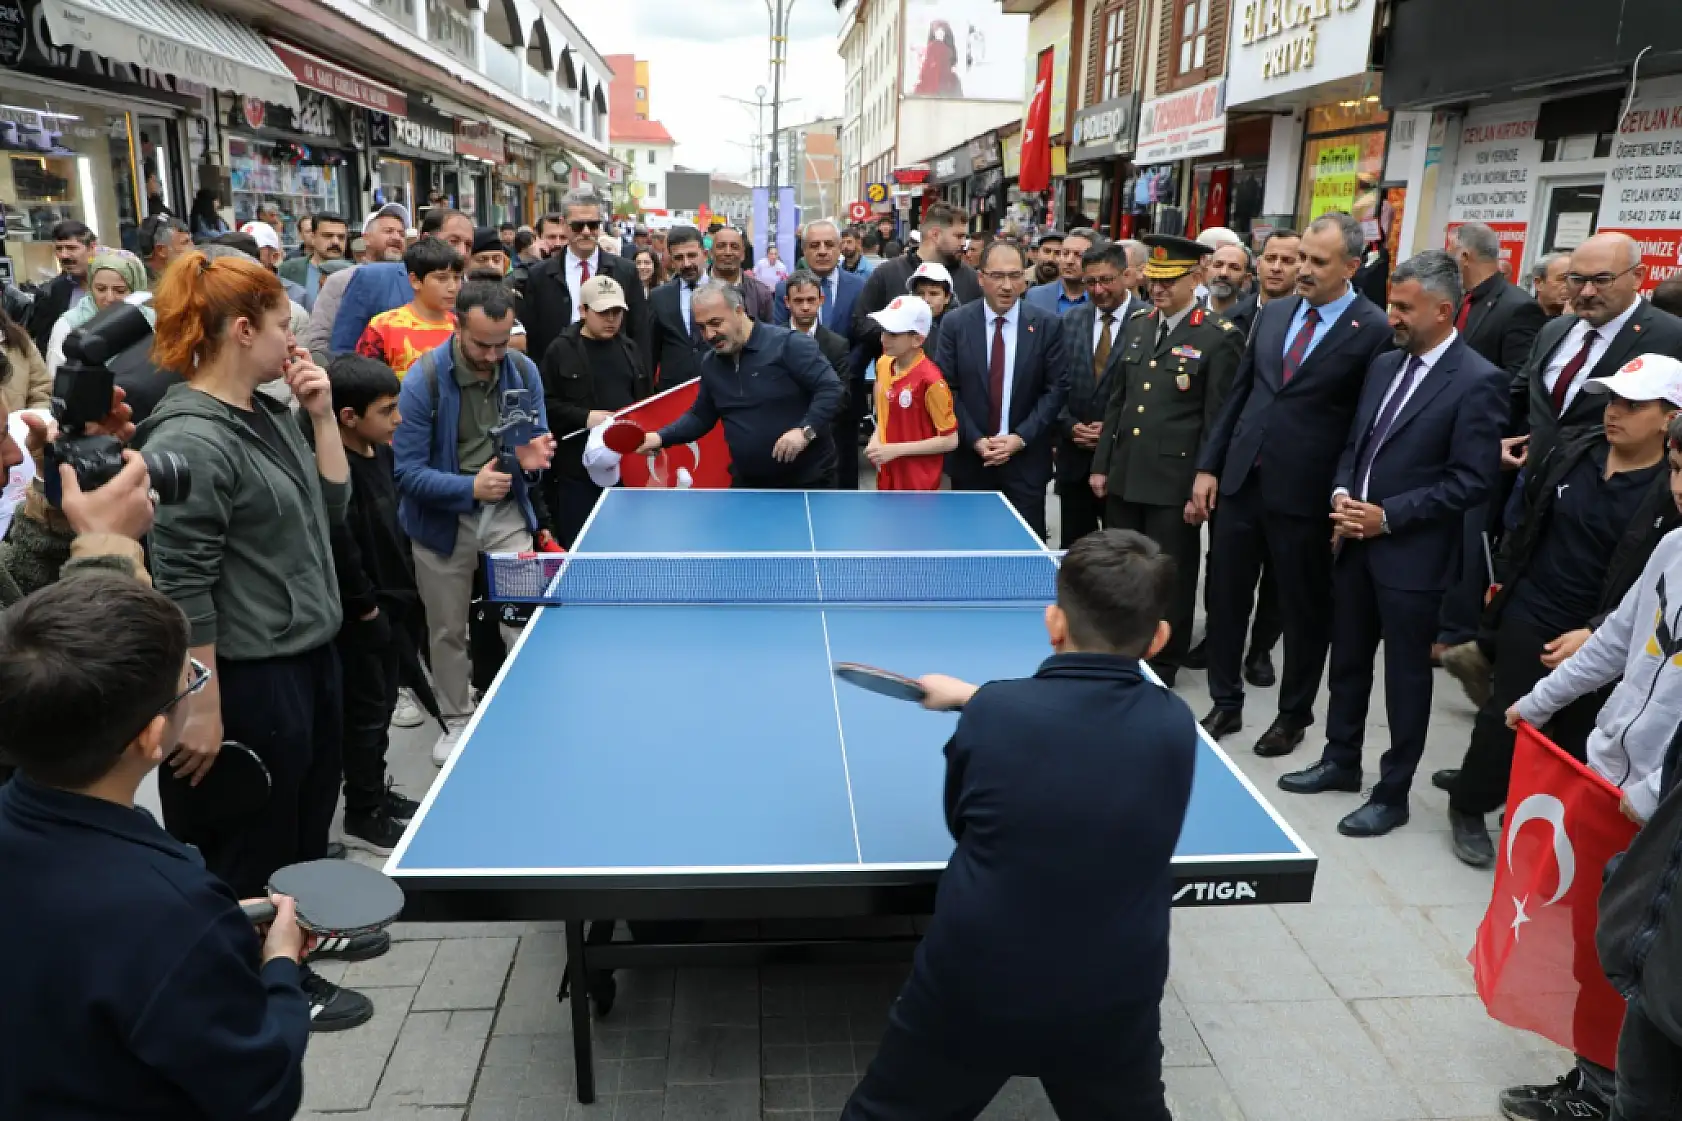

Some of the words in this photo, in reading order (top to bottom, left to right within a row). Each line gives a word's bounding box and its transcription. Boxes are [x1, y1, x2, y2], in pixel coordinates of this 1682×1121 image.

[1620, 107, 1669, 134] CEYLAN
[1464, 124, 1497, 145] CEYLAN
[1319, 148, 1356, 175] BÜTÜN
[1635, 163, 1653, 179] ÖZEL
[1621, 188, 1649, 203] CEYLAN
[1669, 209, 1681, 221] 44
